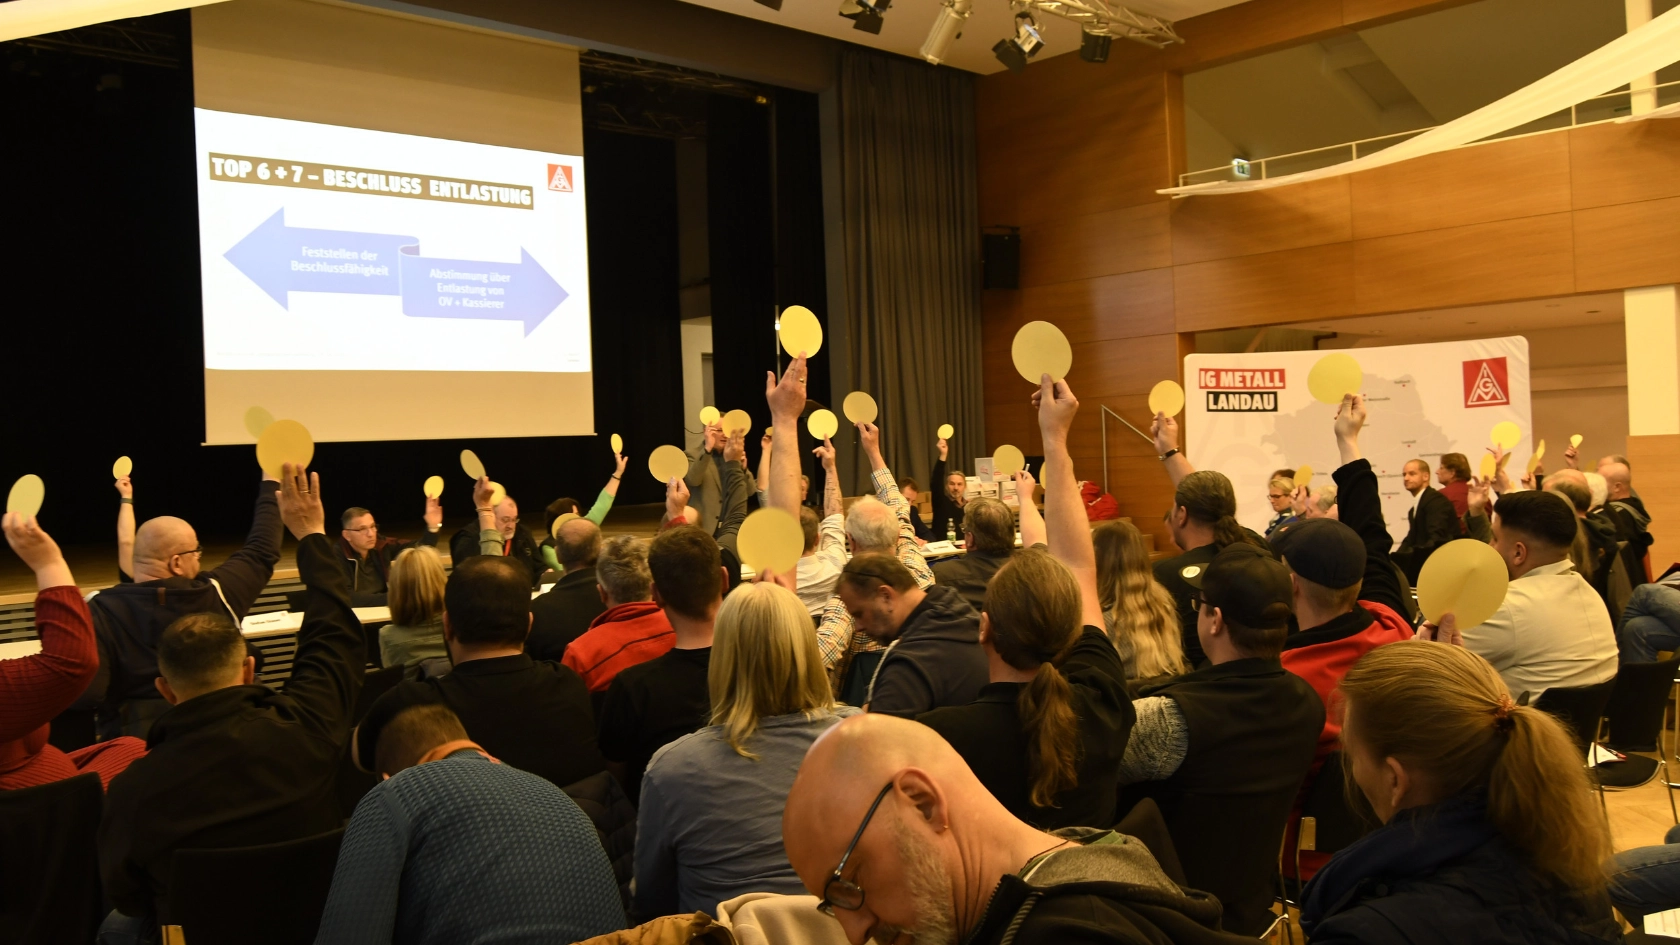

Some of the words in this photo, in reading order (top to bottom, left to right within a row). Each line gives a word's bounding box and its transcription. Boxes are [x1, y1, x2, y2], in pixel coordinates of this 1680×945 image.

[211, 157, 253, 179] TOP
[256, 162, 271, 181] 6
[274, 166, 288, 180] +
[290, 165, 304, 183] 7
[322, 168, 423, 195] BESCHLUSS
[429, 179, 532, 206] ENTLASTUNG
[301, 245, 359, 260] Feststellen
[360, 249, 378, 261] der
[290, 259, 389, 277] Beschlussfähigkeit
[429, 268, 489, 284] Abstimmung
[489, 271, 511, 283] über
[436, 282, 487, 297] Entlastung
[487, 287, 505, 296] von
[438, 296, 453, 307] OV
[462, 297, 505, 309] Kassierer
[1200, 370, 1217, 387] IG
[1220, 371, 1284, 388] METALL
[1208, 393, 1275, 410] LANDAU
